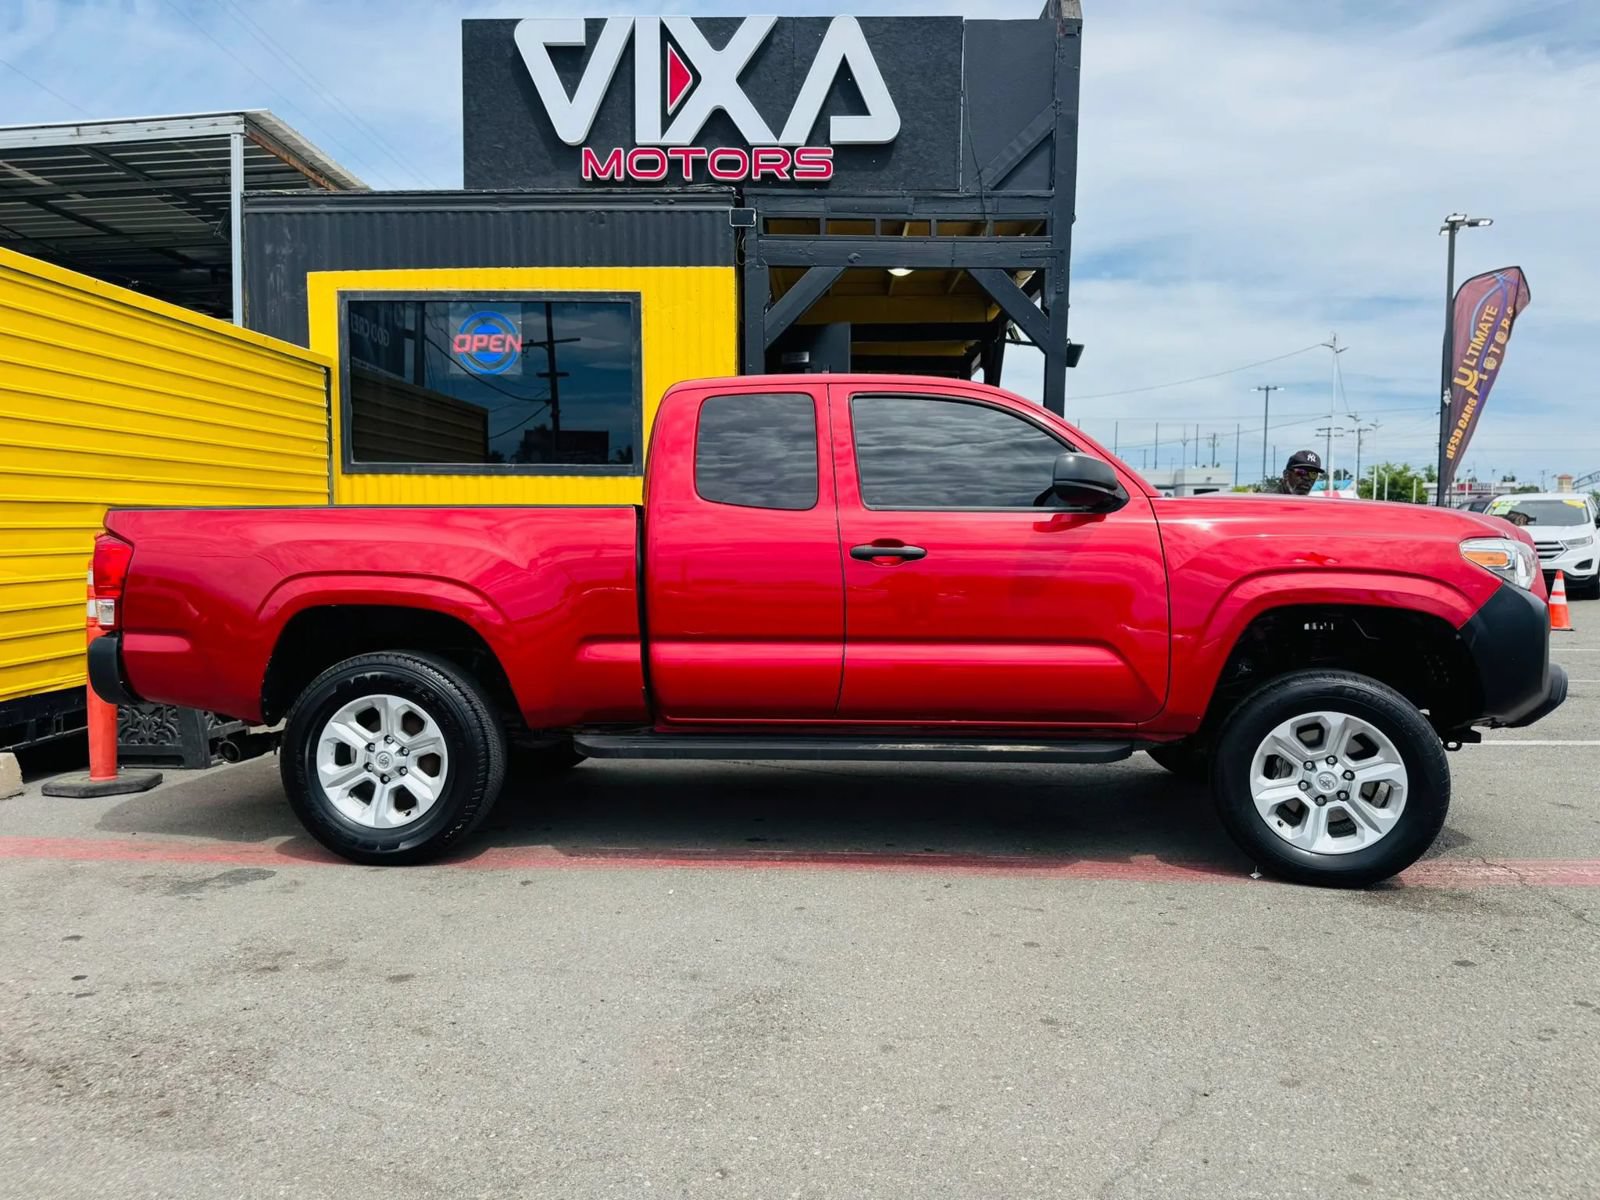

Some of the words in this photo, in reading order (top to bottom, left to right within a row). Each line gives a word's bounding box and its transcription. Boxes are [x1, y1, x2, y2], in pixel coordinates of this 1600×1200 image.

[514, 14, 901, 146] VIXA
[581, 146, 834, 182] MOTORS
[452, 333, 523, 353] OPEN
[1453, 305, 1498, 387] ULTIMATE
[1458, 397, 1478, 430] CARS
